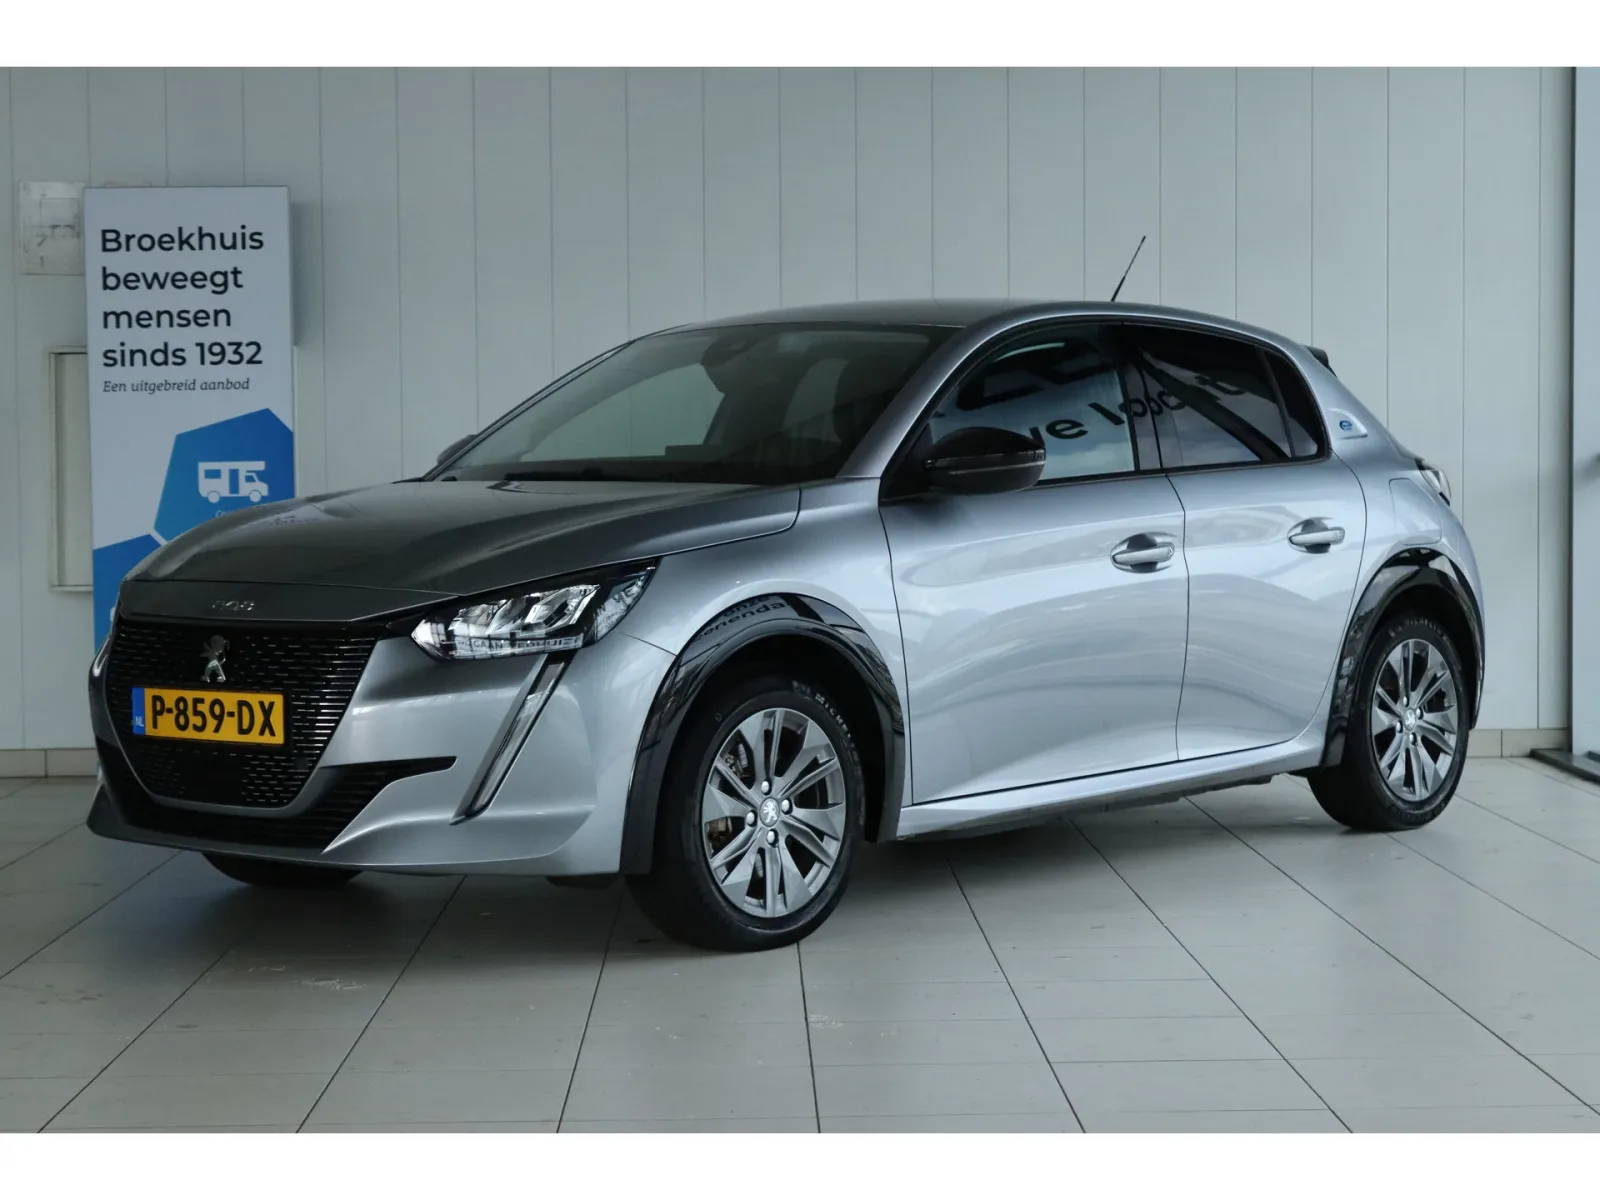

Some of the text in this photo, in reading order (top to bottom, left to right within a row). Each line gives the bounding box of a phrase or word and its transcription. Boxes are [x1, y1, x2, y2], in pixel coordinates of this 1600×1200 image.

[101, 225, 264, 252] Broekhuis
[101, 266, 244, 295] beweegt
[103, 307, 231, 329] mensen
[102, 341, 263, 367] sinds 1932
[102, 378, 250, 394] Een uitgebreid aanbod
[135, 695, 276, 737] NL P-859-DX
